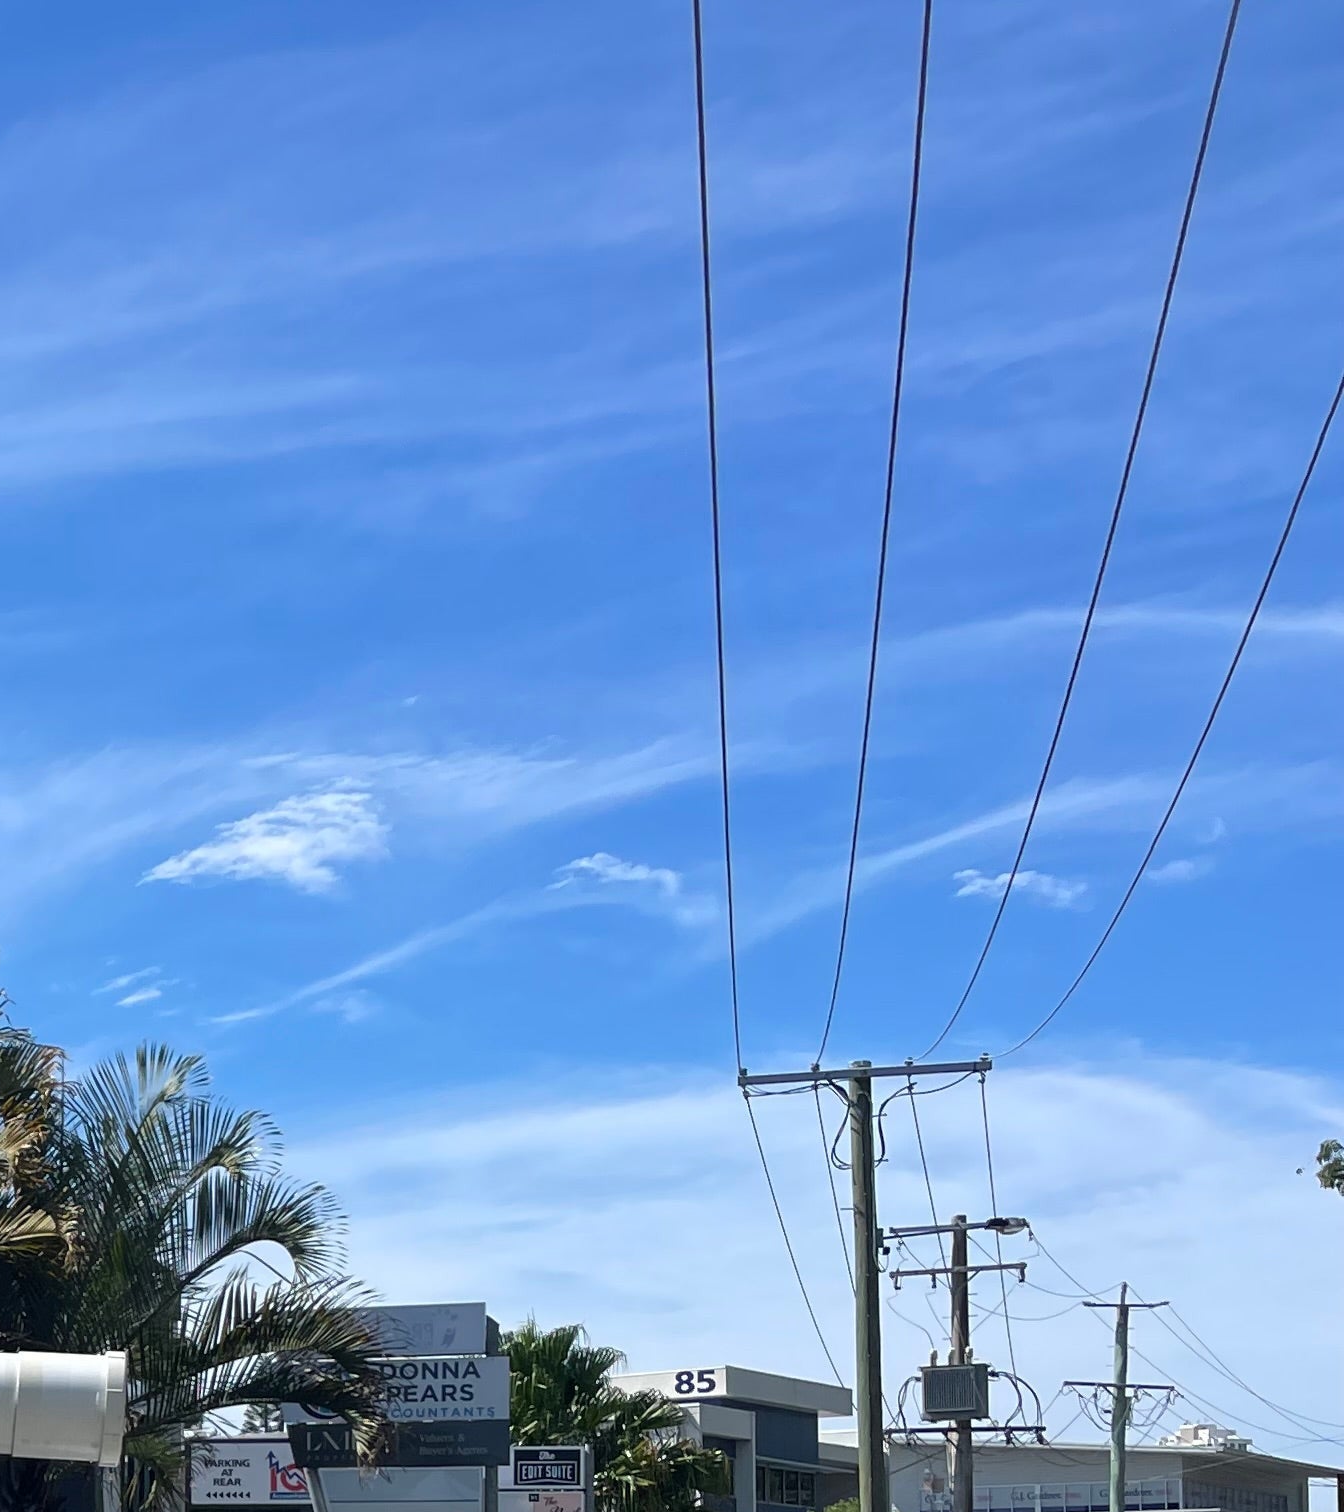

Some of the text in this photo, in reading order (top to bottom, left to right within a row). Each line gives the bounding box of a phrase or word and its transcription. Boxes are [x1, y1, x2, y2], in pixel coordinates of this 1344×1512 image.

[380, 1361, 480, 1380] DONNA
[674, 1370, 717, 1395] 85
[386, 1384, 474, 1402] PEARS
[205, 1459, 250, 1468] PARKING
[221, 1469, 233, 1477] AT
[522, 1465, 573, 1479] EDIT SUITE
[213, 1478, 241, 1486] REAR
